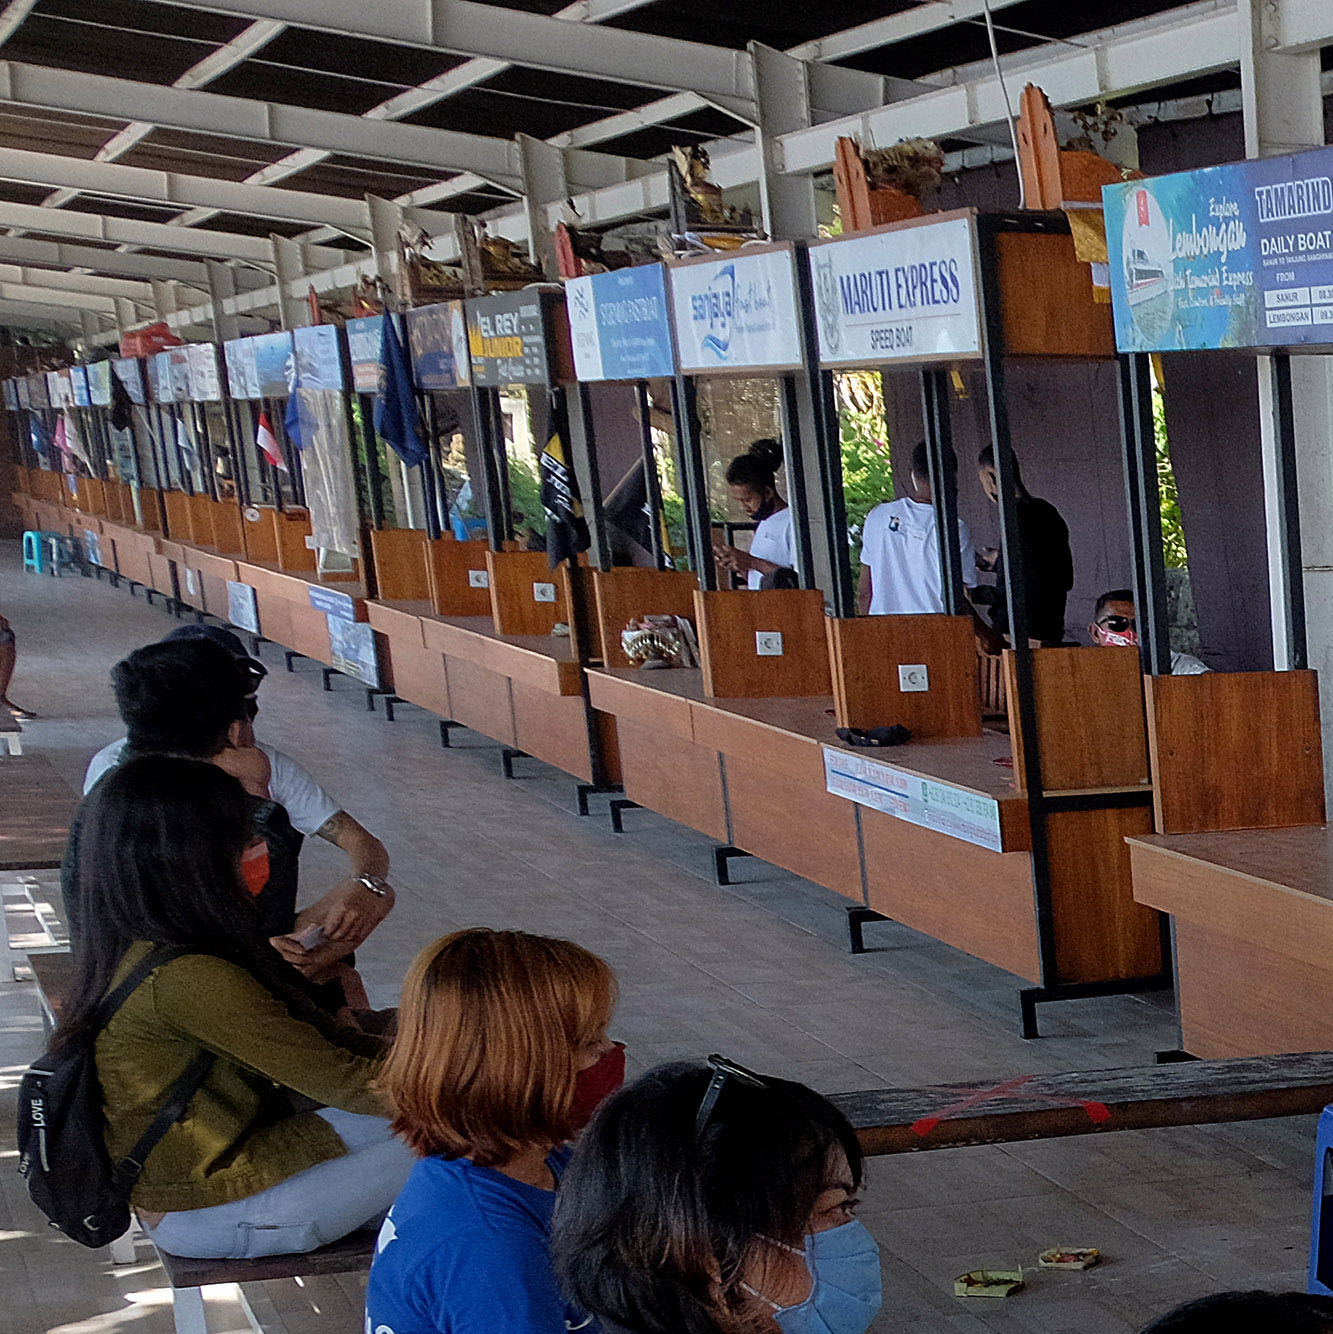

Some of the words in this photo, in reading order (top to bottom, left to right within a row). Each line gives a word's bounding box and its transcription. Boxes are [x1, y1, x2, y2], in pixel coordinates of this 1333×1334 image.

[1209, 196, 1240, 222] Explore
[1256, 179, 1332, 223] TAMARIND
[1261, 235, 1295, 256] DAILY
[1298, 230, 1332, 251] BOAT
[840, 268, 893, 315] MARUTI
[895, 258, 960, 309] EXPRESS
[1221, 266, 1255, 291] Express
[1276, 271, 1295, 282] FROM
[480, 315, 495, 338] EL
[495, 312, 519, 336] REY
[1269, 312, 1309, 324] LEMBONGAN
[31, 1098, 44, 1128] LOVE
